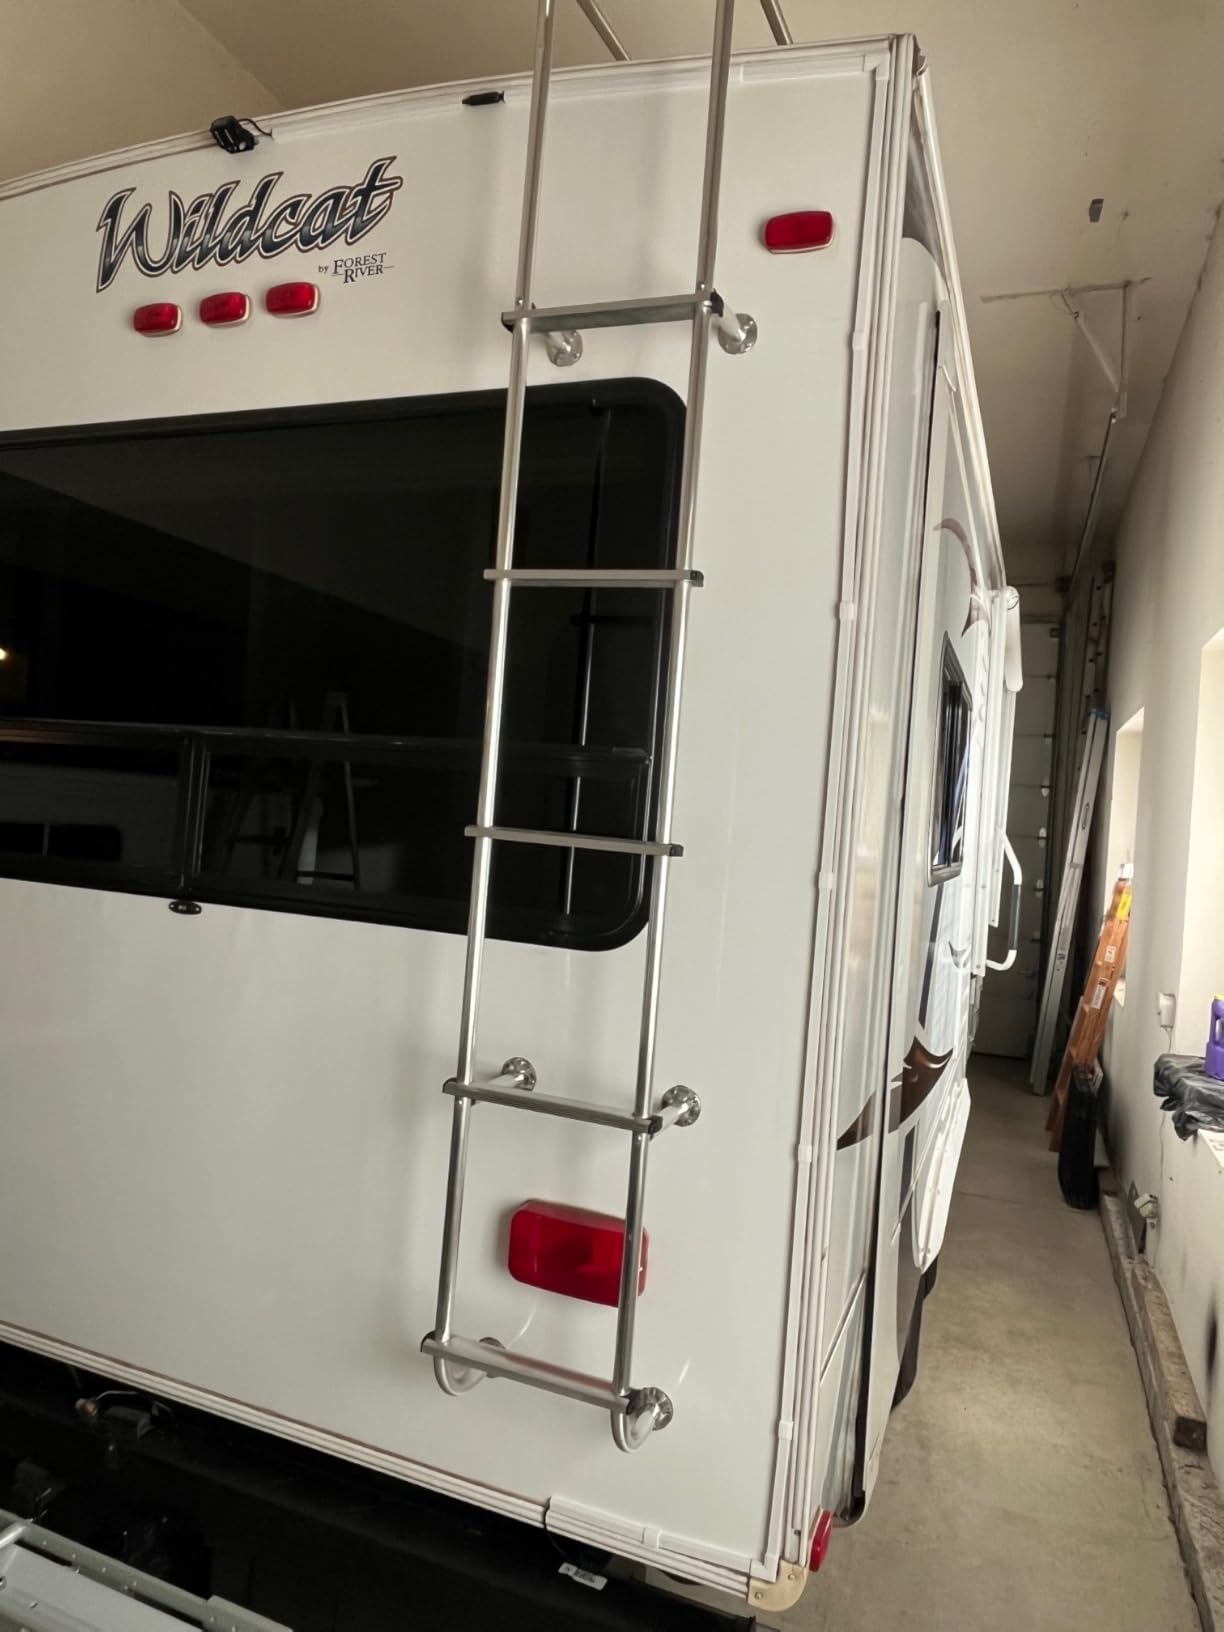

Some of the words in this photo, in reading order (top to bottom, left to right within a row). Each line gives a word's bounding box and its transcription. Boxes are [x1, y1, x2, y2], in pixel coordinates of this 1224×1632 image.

[96, 156, 403, 293] Wildcat
[318, 264, 329, 274] by
[333, 252, 387, 274] FOREST
[343, 264, 384, 284] RIVER
